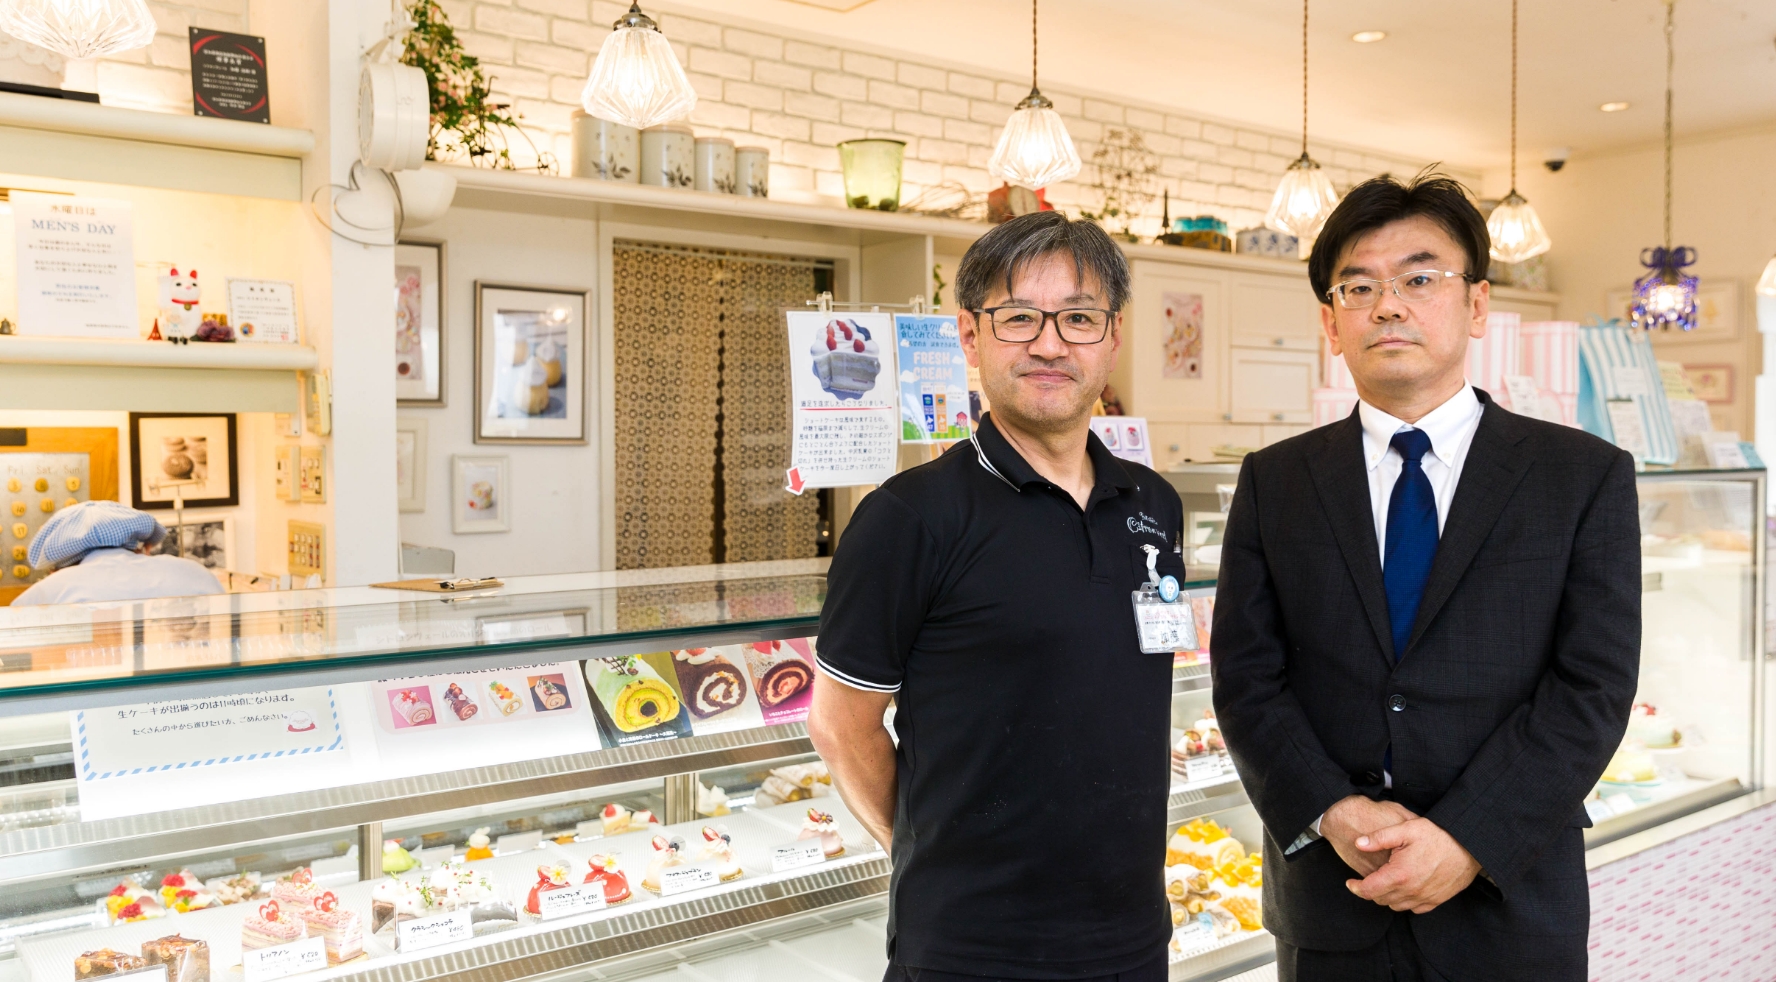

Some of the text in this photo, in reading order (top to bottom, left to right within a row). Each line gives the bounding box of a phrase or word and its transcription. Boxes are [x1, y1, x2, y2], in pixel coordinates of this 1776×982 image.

[51, 205, 96, 216] 水曜日は
[31, 219, 116, 235] MEN'S DAY
[913, 351, 951, 365] FRESH
[912, 366, 953, 380] CREAM
